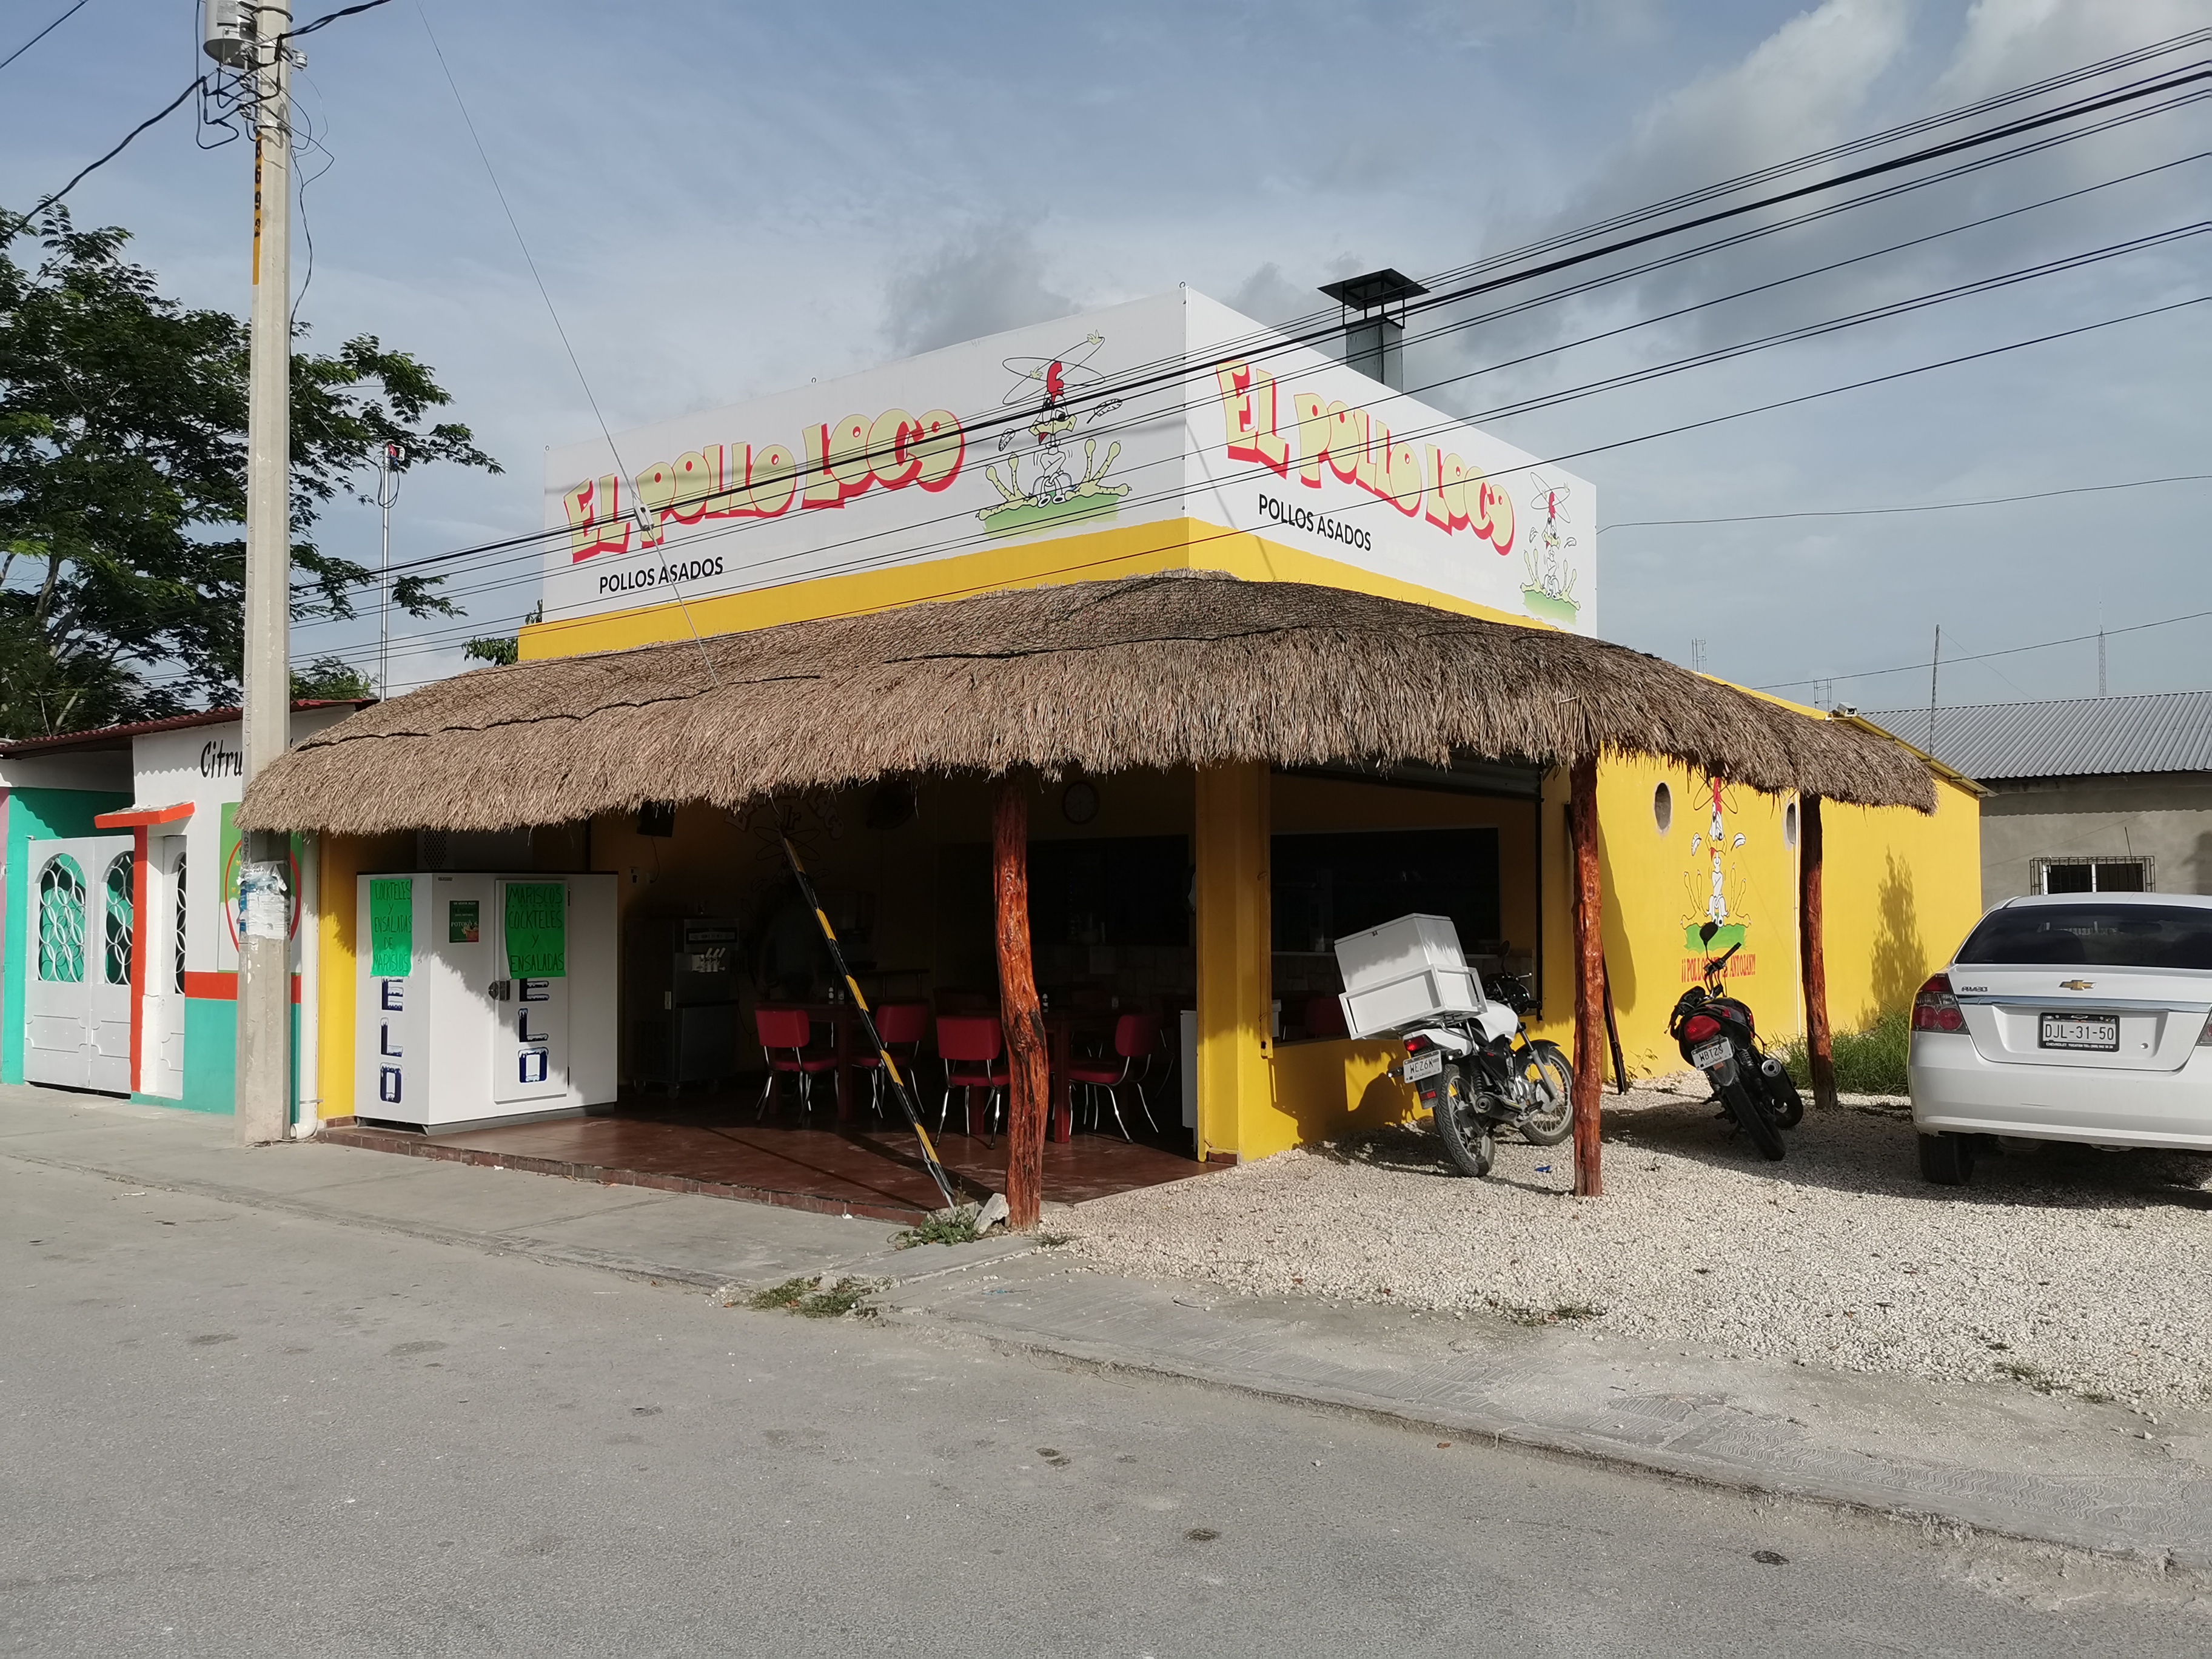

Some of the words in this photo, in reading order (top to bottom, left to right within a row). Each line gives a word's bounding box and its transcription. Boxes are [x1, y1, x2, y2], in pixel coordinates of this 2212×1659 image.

[1216, 360, 1289, 480] EL
[1282, 393, 1422, 517] POLLO
[1425, 443, 1514, 555] LOCO
[564, 472, 631, 563] EL
[635, 441, 797, 548] POLLO
[802, 408, 965, 509] LOCO
[1259, 494, 1314, 532] POLLOS
[1316, 515, 1371, 552] ASADOS
[600, 568, 655, 594] POLLOS
[658, 556, 723, 585] ASADOS
[201, 739, 243, 779] Citru
[375, 881, 411, 901] COCKTELES
[508, 886, 563, 904] MARISCOS
[374, 914, 412, 933] ENSALADAS
[508, 910, 562, 930] COCKTELES
[383, 937, 394, 950] DE
[372, 953, 409, 974] MARISCOS
[510, 953, 565, 973] ENSALADAS
[1681, 958, 1708, 983] ¡¡POLLO
[380, 976, 404, 1104] ELO
[518, 978, 550, 1083] ELO
[2045, 1024, 2114, 1041] DJL-31-50
[1410, 1057, 1433, 1074] WEZ6K
